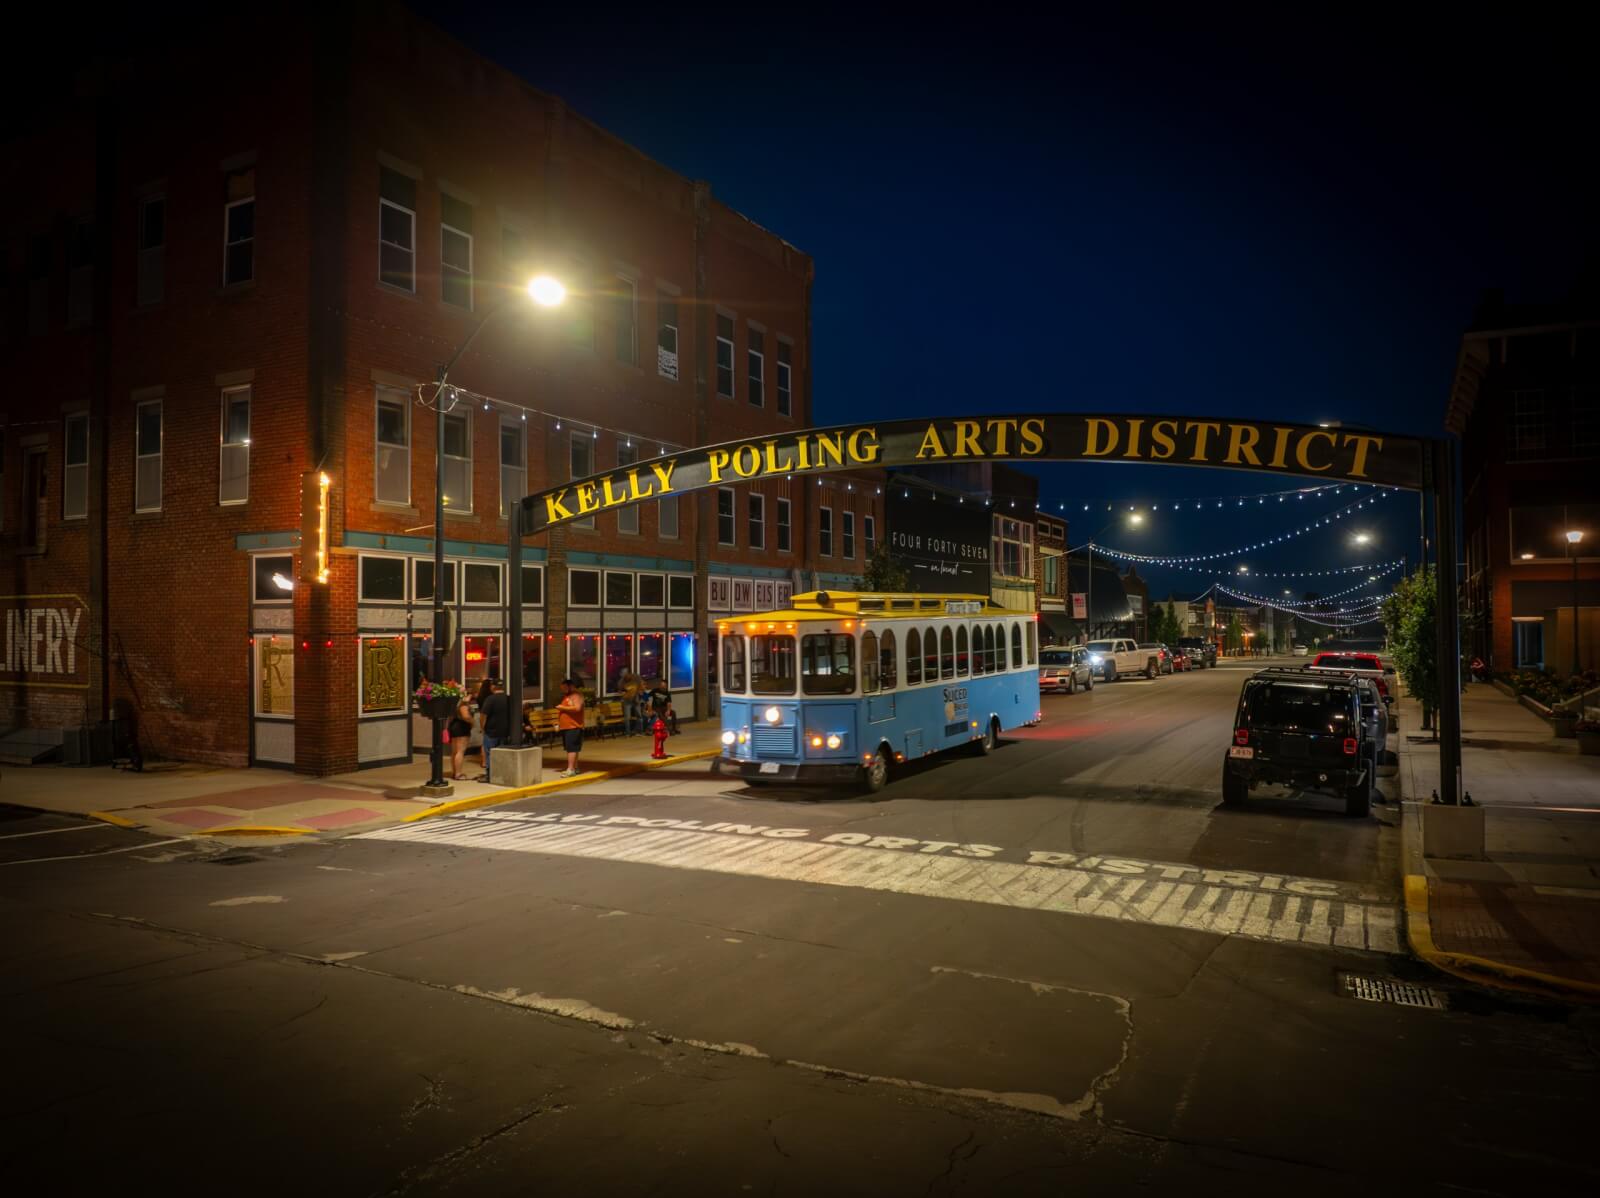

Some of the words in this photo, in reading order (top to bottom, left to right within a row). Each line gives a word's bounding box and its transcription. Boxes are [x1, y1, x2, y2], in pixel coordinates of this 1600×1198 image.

[542, 458, 677, 525] KELLY
[708, 426, 880, 484] POLING
[915, 417, 1048, 459] ARTS
[1082, 417, 1384, 478] DISTRICT
[892, 531, 921, 550] FOUR
[927, 537, 958, 555] FORTY
[960, 543, 988, 560] SEVEN
[368, 646, 397, 688] R
[597, 814, 810, 839] POLING
[820, 832, 1004, 858] ARTS
